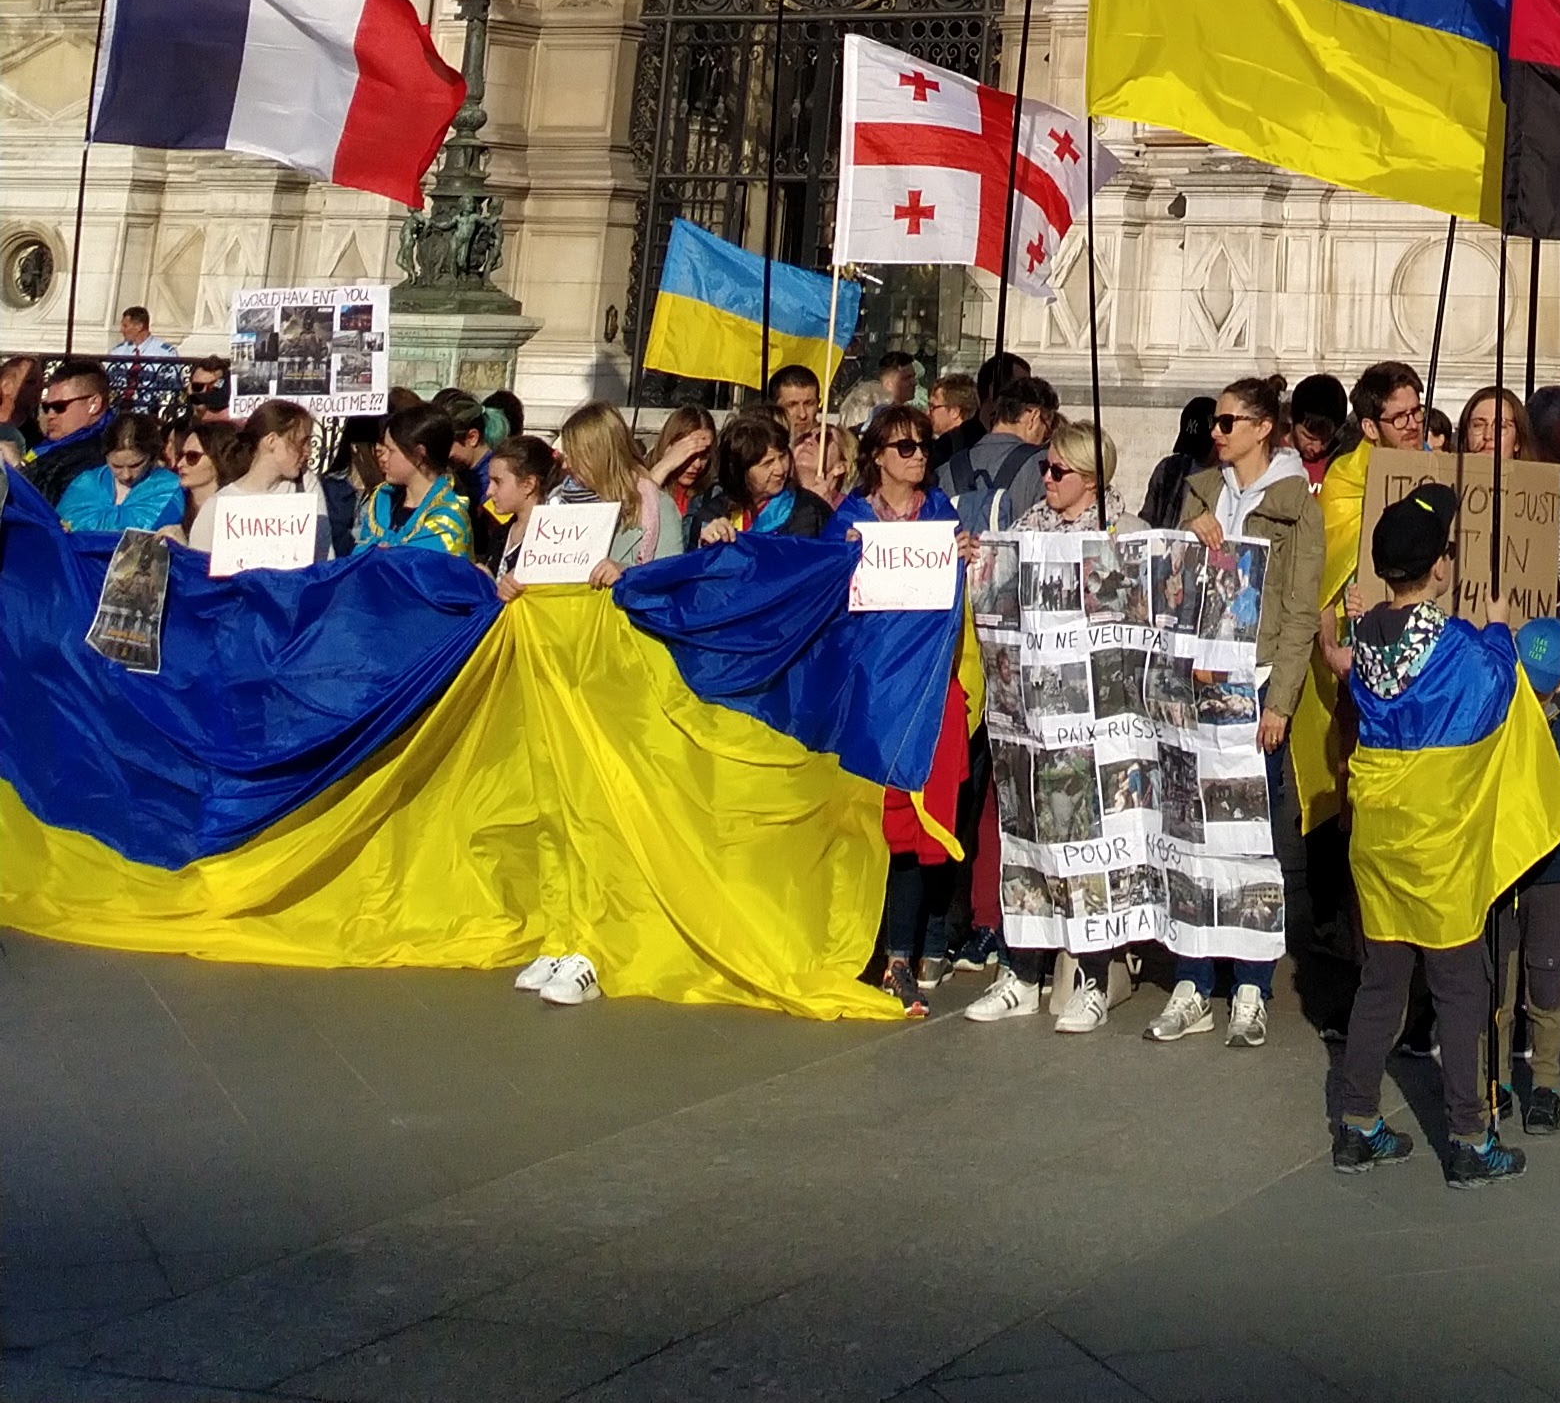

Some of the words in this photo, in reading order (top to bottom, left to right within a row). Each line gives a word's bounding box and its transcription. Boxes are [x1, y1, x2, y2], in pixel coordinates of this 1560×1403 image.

[343, 287, 369, 302] YOU
[309, 396, 348, 413] ABOUT
[350, 394, 367, 411] ME
[860, 540, 954, 570] KHERSON
[1026, 632, 1044, 651] ON
[1056, 631, 1078, 649] NE
[1088, 625, 1135, 647] VEUT
[1142, 627, 1169, 652] PAS
[1108, 719, 1164, 740] RUSSE
[1062, 836, 1131, 866] POUR
[1084, 910, 1179, 943] ENFANTS
